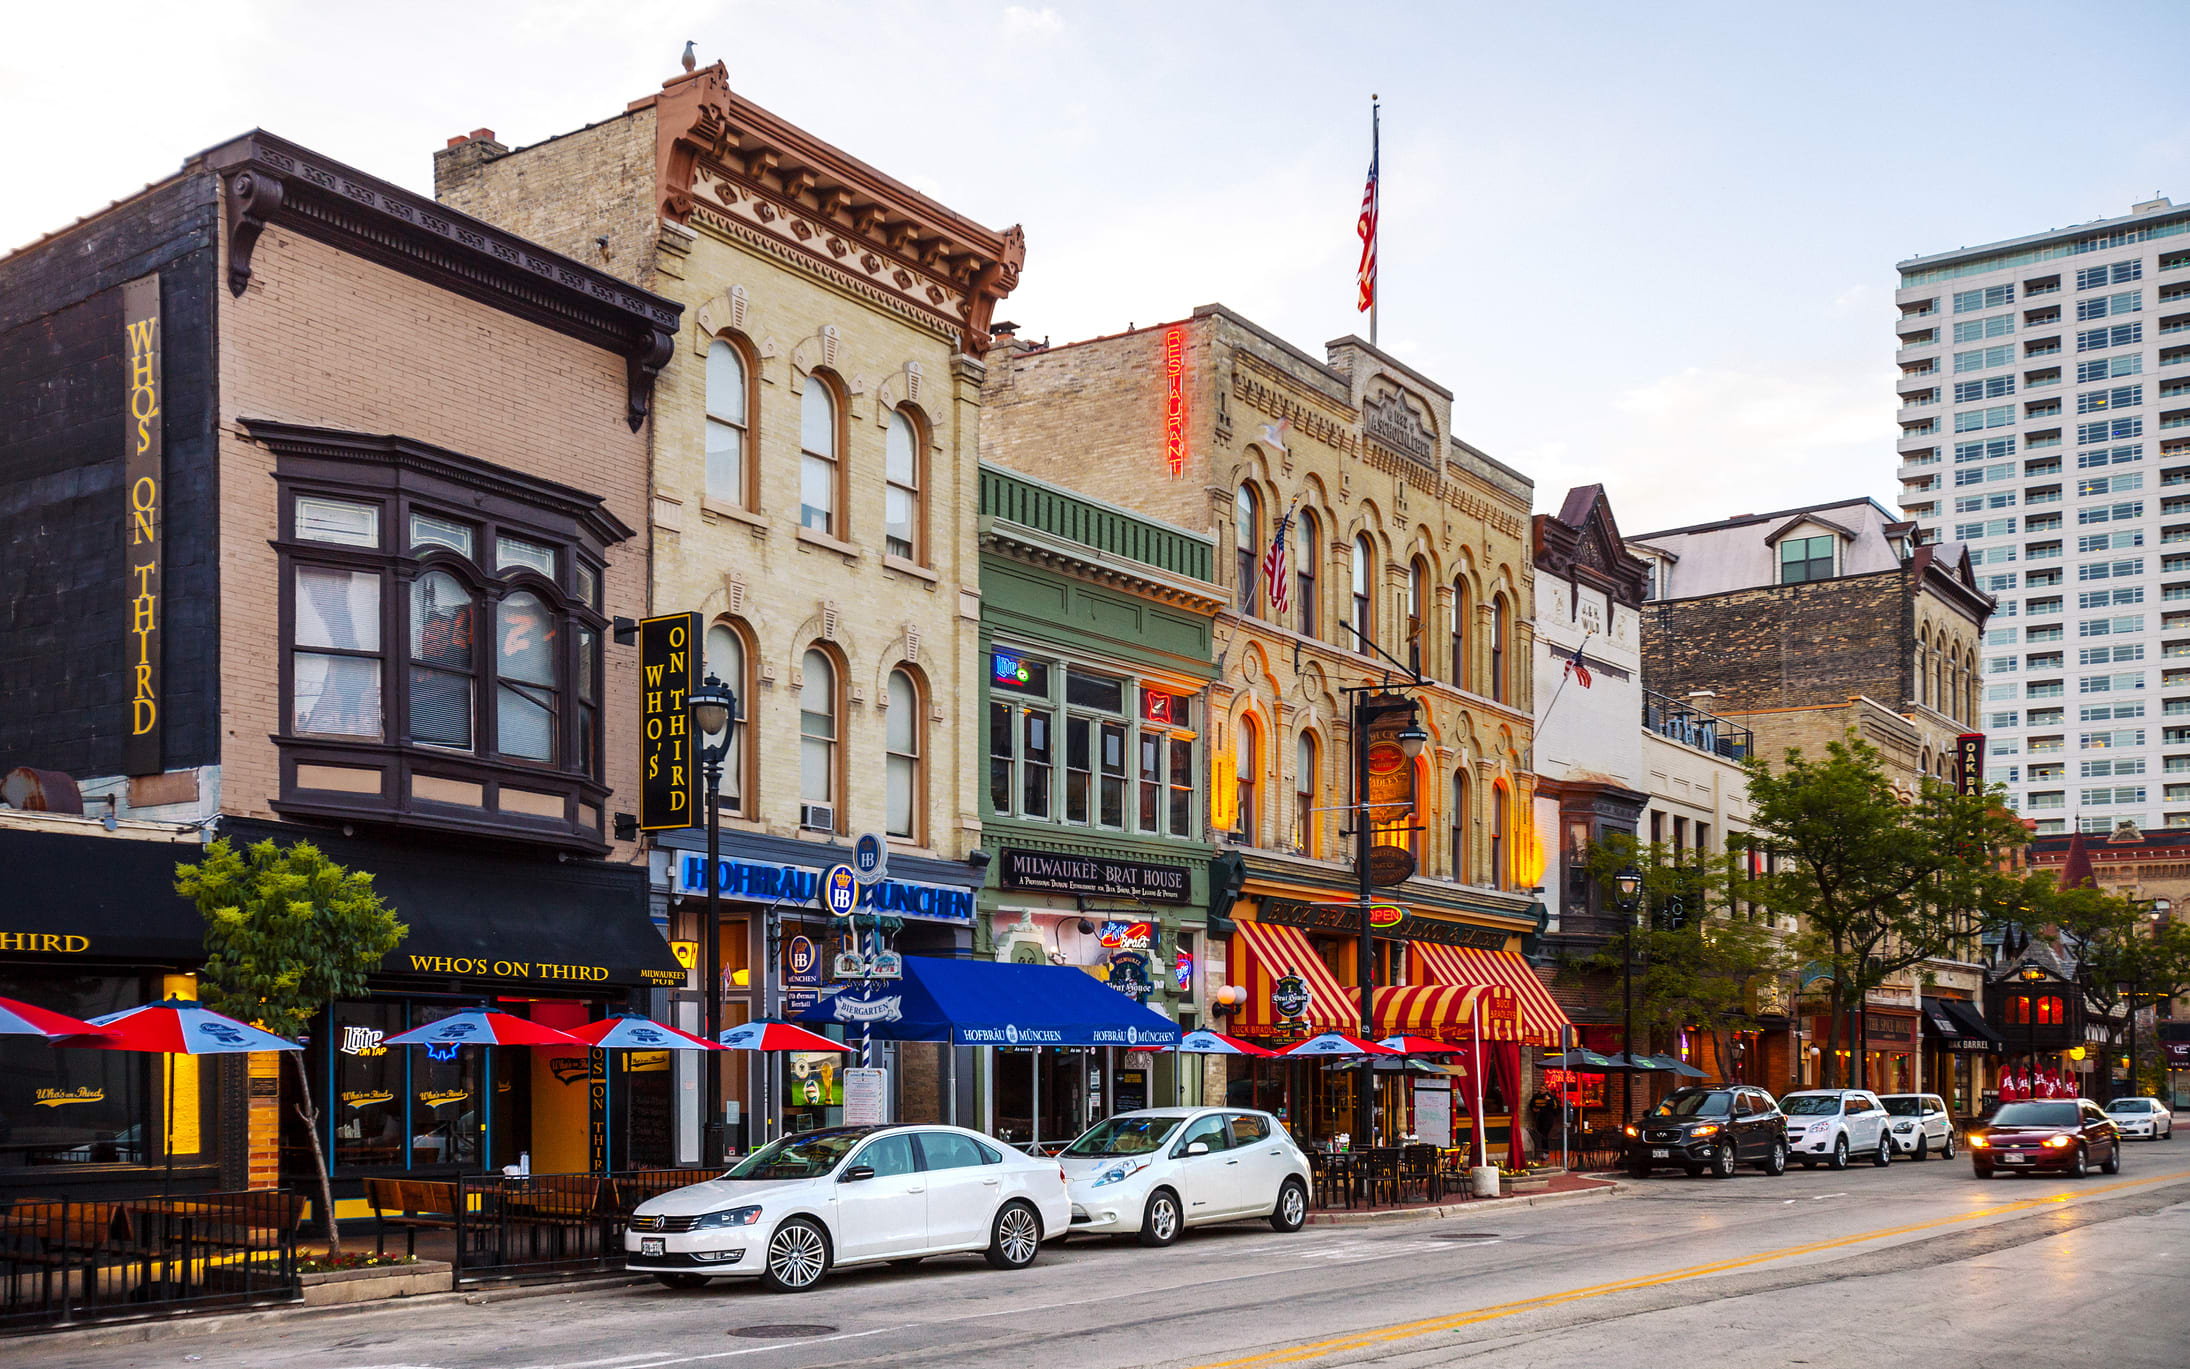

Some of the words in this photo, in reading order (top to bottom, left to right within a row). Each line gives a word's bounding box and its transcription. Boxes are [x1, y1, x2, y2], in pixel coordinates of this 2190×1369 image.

[127, 317, 159, 456] WHO'S
[1168, 331, 1181, 473] RESTAURANT
[132, 476, 156, 544] ON
[132, 561, 156, 735] THIRD
[669, 626, 685, 673] ON
[645, 664, 664, 779] WHO'S
[669, 688, 685, 811] THIRD
[1966, 743, 1976, 773] OAK
[861, 852, 874, 867] HB
[686, 856, 817, 899] HOFBRÄU
[1014, 855, 1098, 880] MILWAUKEE
[1105, 865, 1137, 884] BRAT
[1144, 870, 1183, 888] HOUSE
[834, 888, 850, 908] HB
[1268, 902, 1313, 924] BUCK
[0, 932, 91, 952] HIRD
[409, 955, 487, 975] WHO'S
[493, 960, 530, 977] ON
[536, 963, 609, 981] THIRD
[794, 953, 807, 967] HB
[641, 969, 686, 980] MILWAUKEE'S
[652, 978, 675, 986] PUB
[841, 1001, 889, 1015] BIERGARTEN
[341, 1026, 383, 1055] Lite
[964, 1027, 1005, 1041] HOFBRÄU
[1018, 1028, 1062, 1041] MÜNCHEN
[1093, 1030, 1127, 1042] HOFBRÄU
[1138, 1030, 1175, 1042] MÜNCHEN
[1231, 1026, 1249, 1034] BUCK
[359, 1047, 371, 1056] ON
[371, 1046, 387, 1056] TAP
[1963, 1040, 1989, 1050] BARREL
[36, 1088, 66, 1100] Who's
[74, 1086, 102, 1099] Third
[593, 1086, 604, 1110] ON
[593, 1121, 604, 1171] THIR
